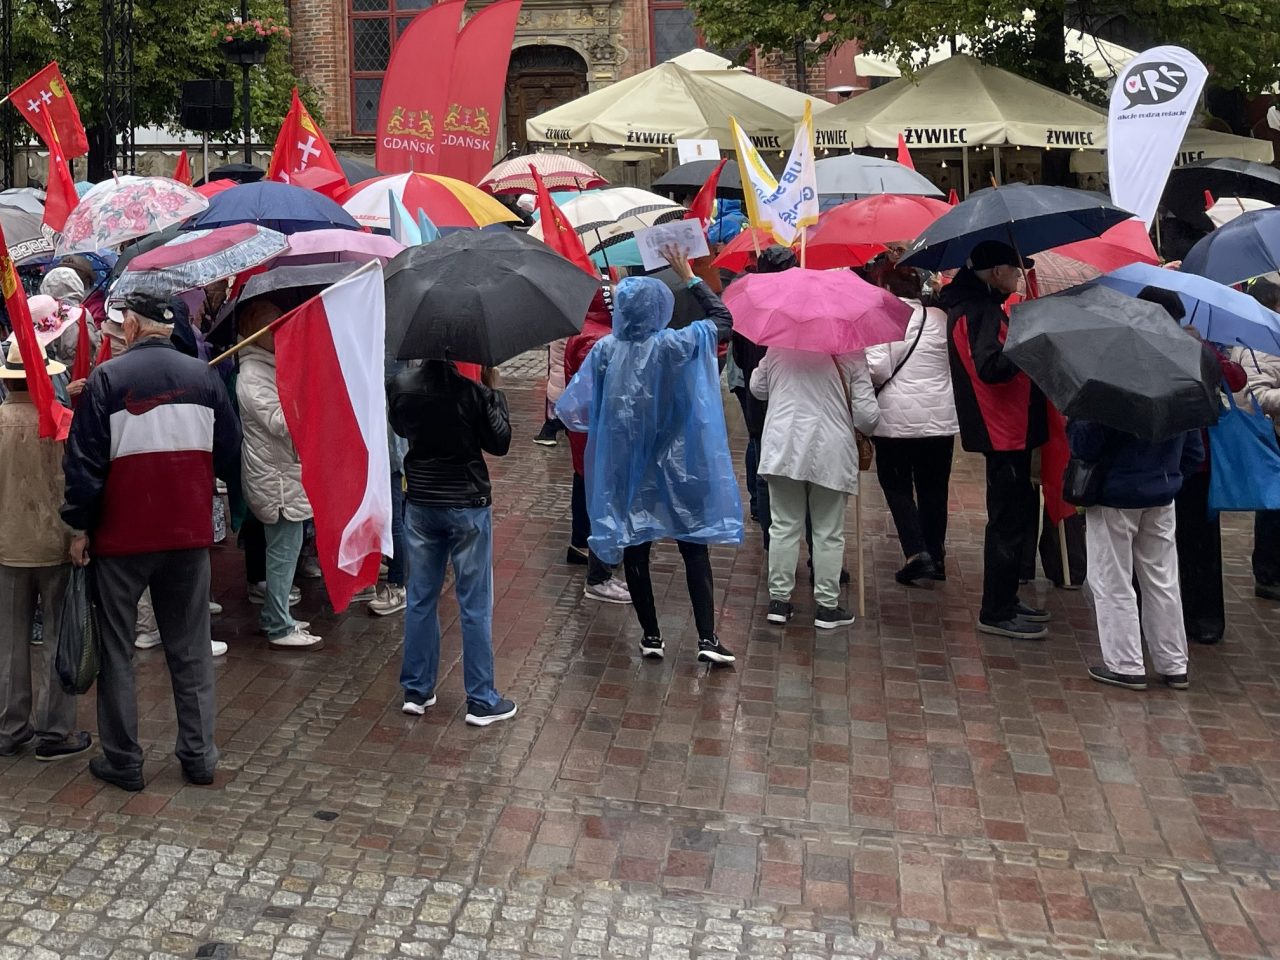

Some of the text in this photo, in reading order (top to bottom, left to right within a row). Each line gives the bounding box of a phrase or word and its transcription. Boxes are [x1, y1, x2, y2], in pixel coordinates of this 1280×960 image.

[627, 129, 675, 144] ŻYWIEC
[815, 129, 847, 145] ŻYWIEC
[904, 127, 967, 144] ŻYWIEC
[1046, 129, 1093, 146] ŻYWIEC
[383, 137, 435, 155] GDAŃSK
